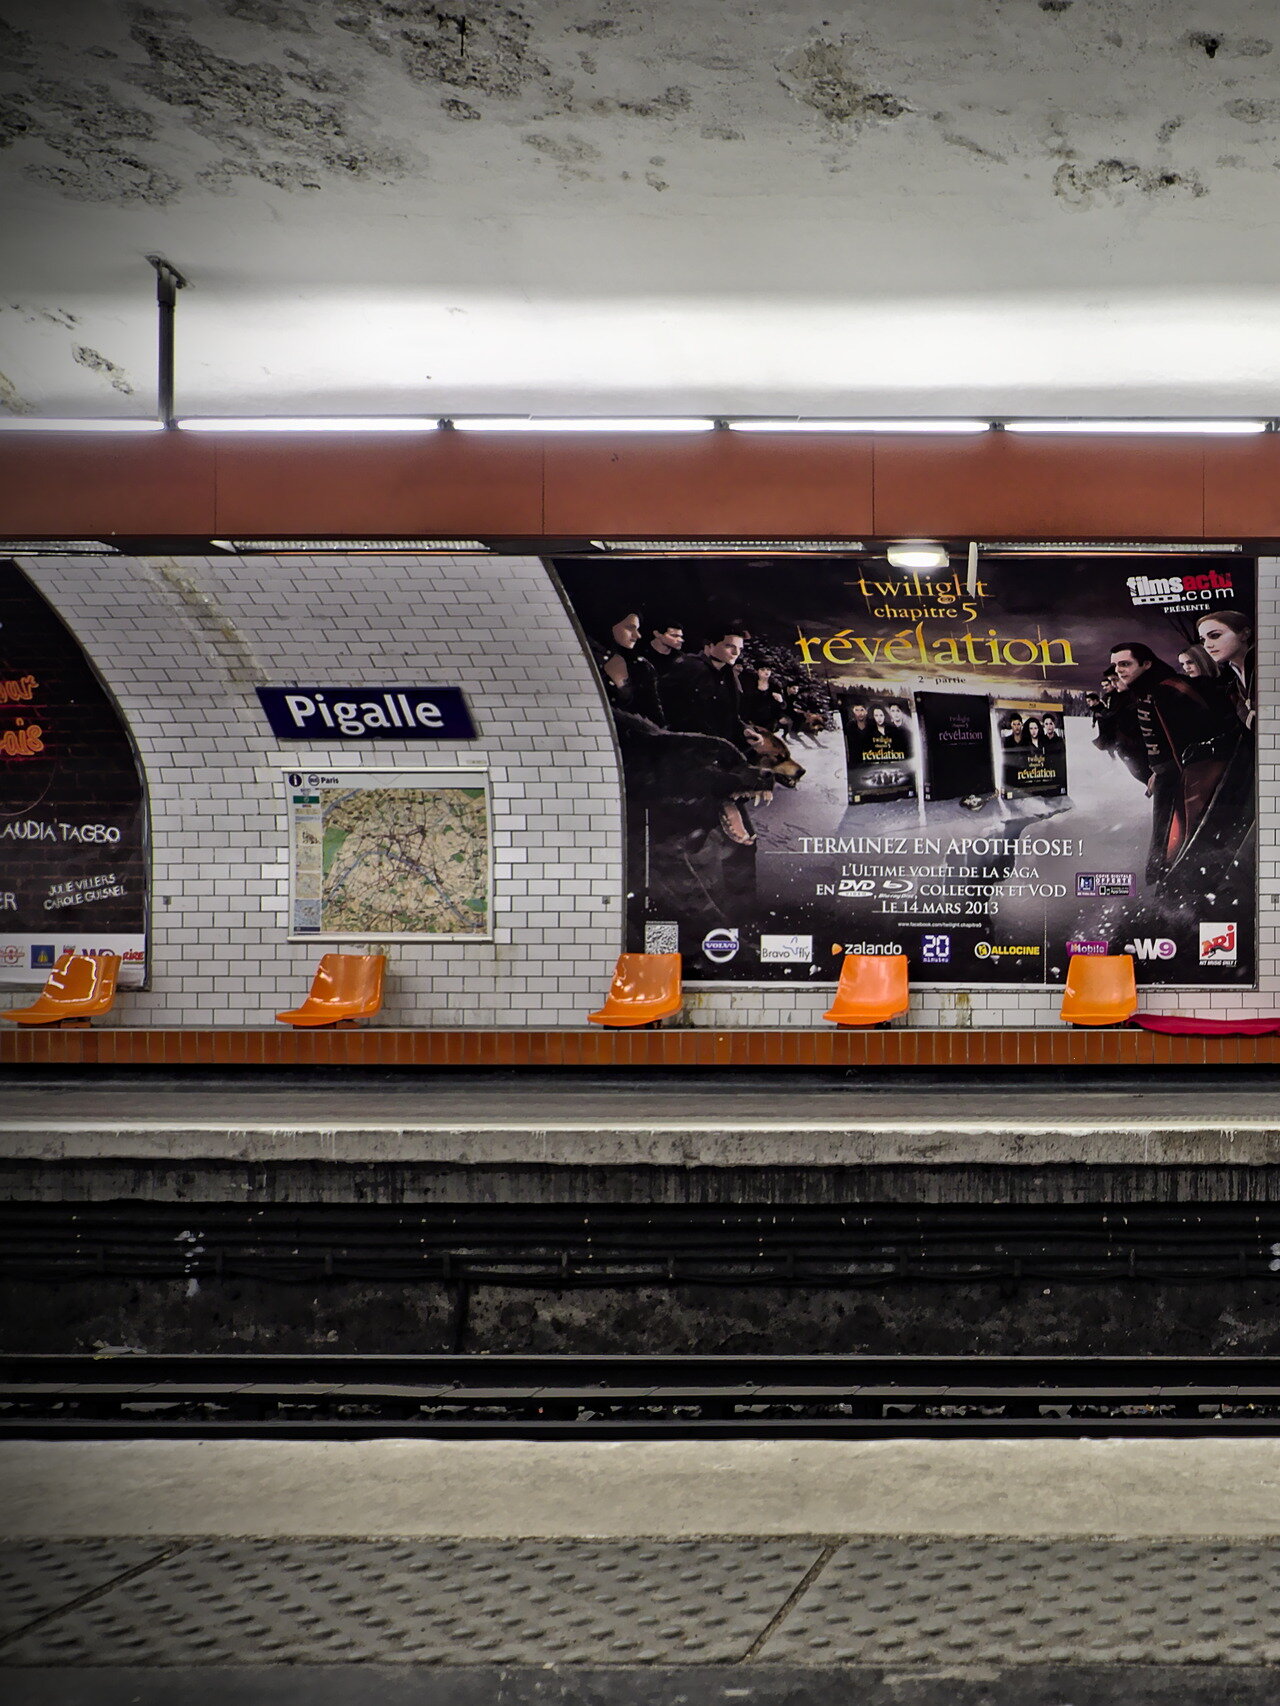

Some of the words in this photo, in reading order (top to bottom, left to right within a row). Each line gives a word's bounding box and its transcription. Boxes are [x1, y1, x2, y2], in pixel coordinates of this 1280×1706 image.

[857, 570, 988, 604] twilight
[874, 604, 958, 621] chapitre
[962, 603, 978, 622] 5
[1163, 604, 1210, 613] PRÉSENTE
[795, 621, 1079, 667] révélation
[935, 676, 966, 685] partie
[284, 693, 445, 736] Pigalle
[1017, 767, 1057, 780] révélation
[0, 820, 57, 841] AUDIA
[59, 823, 120, 843] TAGBO
[799, 837, 908, 855] TERMINEZ
[912, 838, 941, 855] EN
[947, 835, 1073, 857] APOTHÉOSE
[1078, 839, 1084, 857] !
[909, 866, 954, 878] VOLET
[959, 866, 979, 878] DE
[982, 867, 1000, 878] LA
[1002, 867, 1039, 879] SAGA
[816, 884, 835, 896] EN
[920, 884, 1005, 898] COLLECTOR
[1009, 885, 1029, 898] ET
[1030, 885, 1067, 898] VOD
[881, 902, 898, 914] LE
[902, 901, 918, 914] 14
[922, 902, 961, 914] MARS
[965, 901, 999, 915] 2013
[704, 942, 737, 950] VOLVO
[762, 948, 790, 958] Bravo
[798, 946, 810, 960] fly
[844, 941, 902, 955] zalando
[922, 935, 949, 957] 20
[1134, 938, 1177, 960] W9
